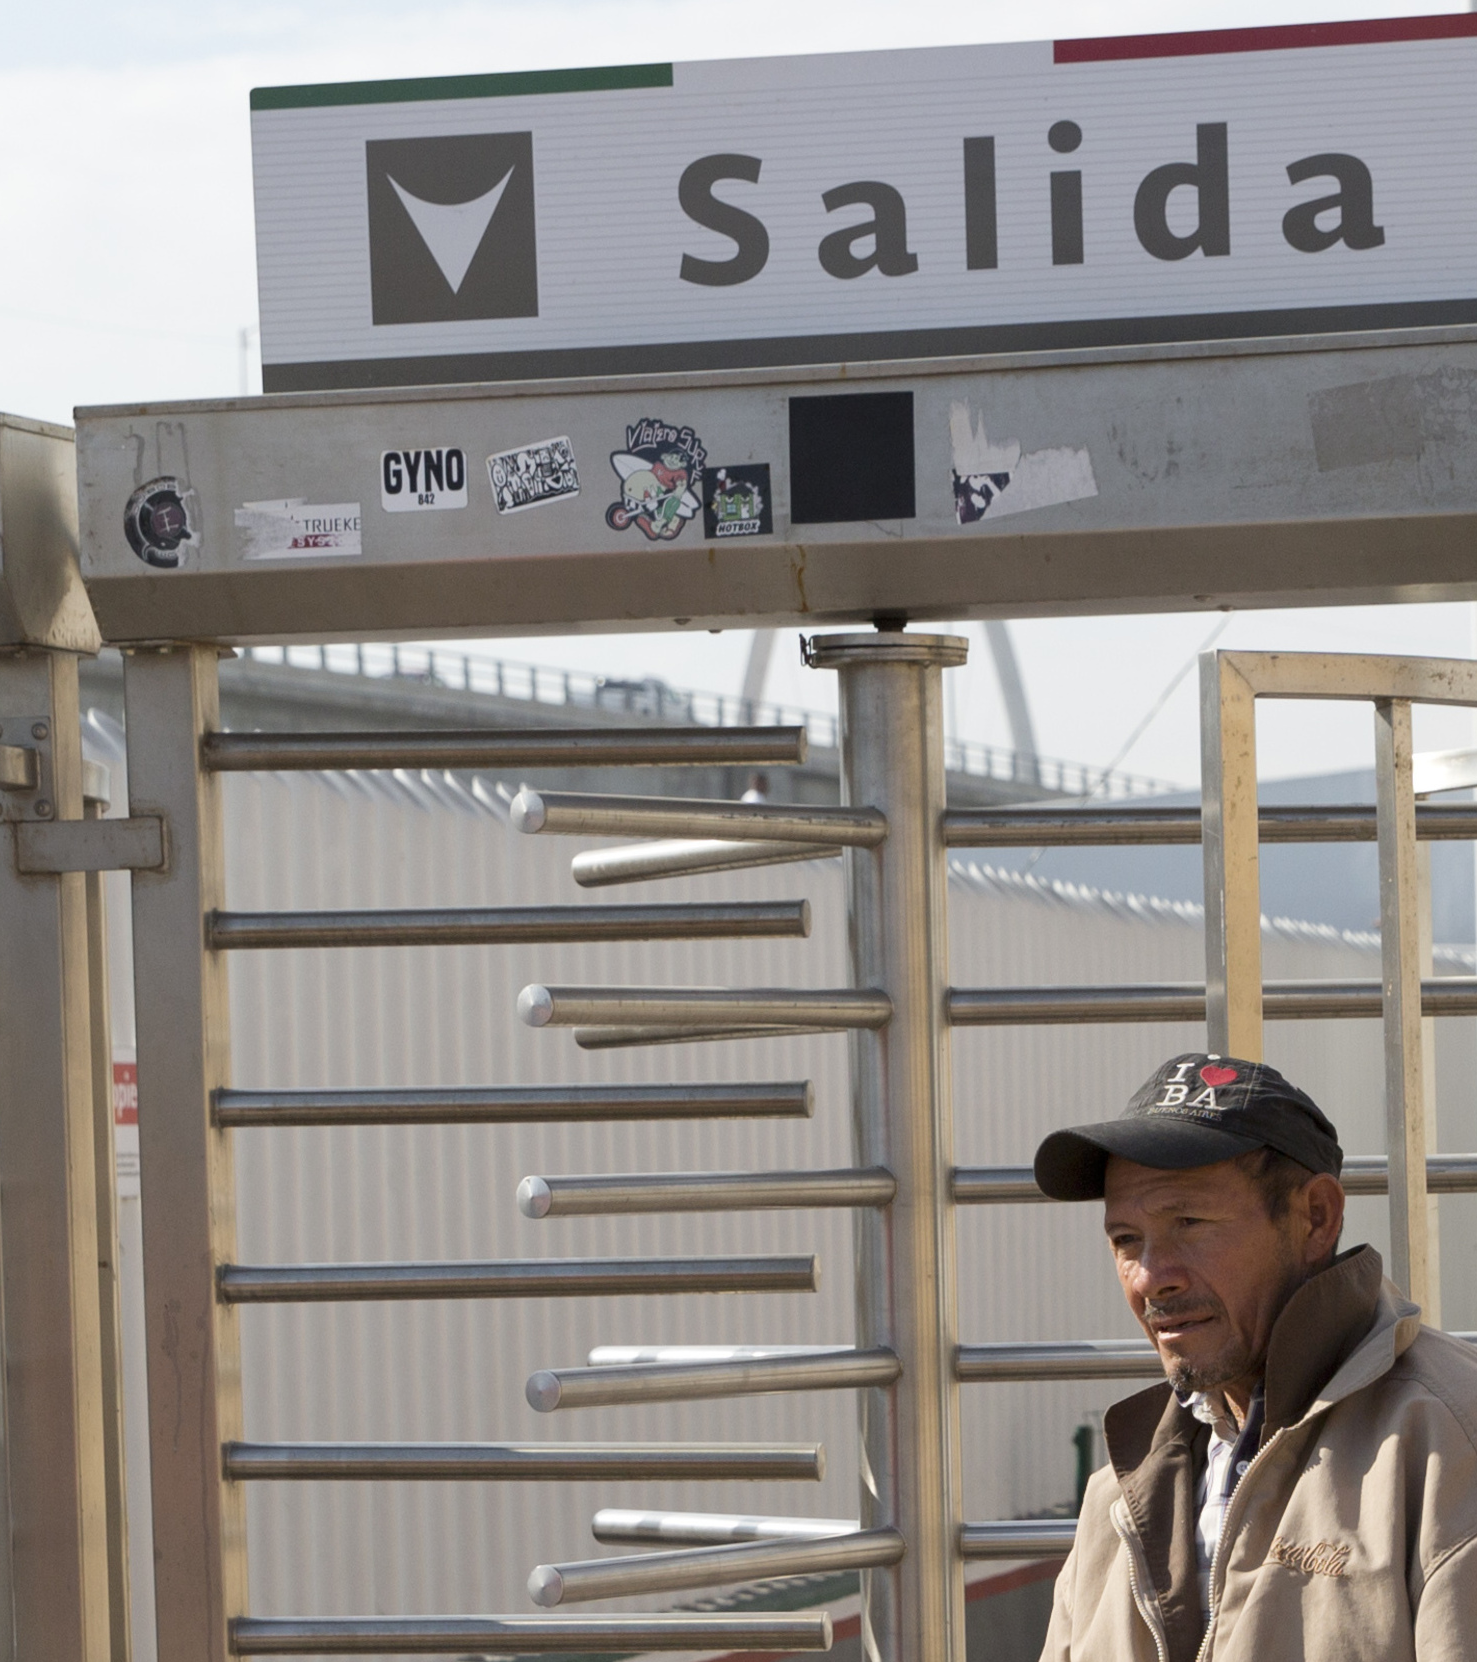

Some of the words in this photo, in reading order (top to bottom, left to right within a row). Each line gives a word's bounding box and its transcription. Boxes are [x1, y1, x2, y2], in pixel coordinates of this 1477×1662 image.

[677, 119, 1385, 288] Salida
[384, 449, 464, 495] GYNO
[718, 522, 760, 534] HOTBOX
[1167, 1062, 1196, 1082] I
[1156, 1084, 1228, 1111] BA
